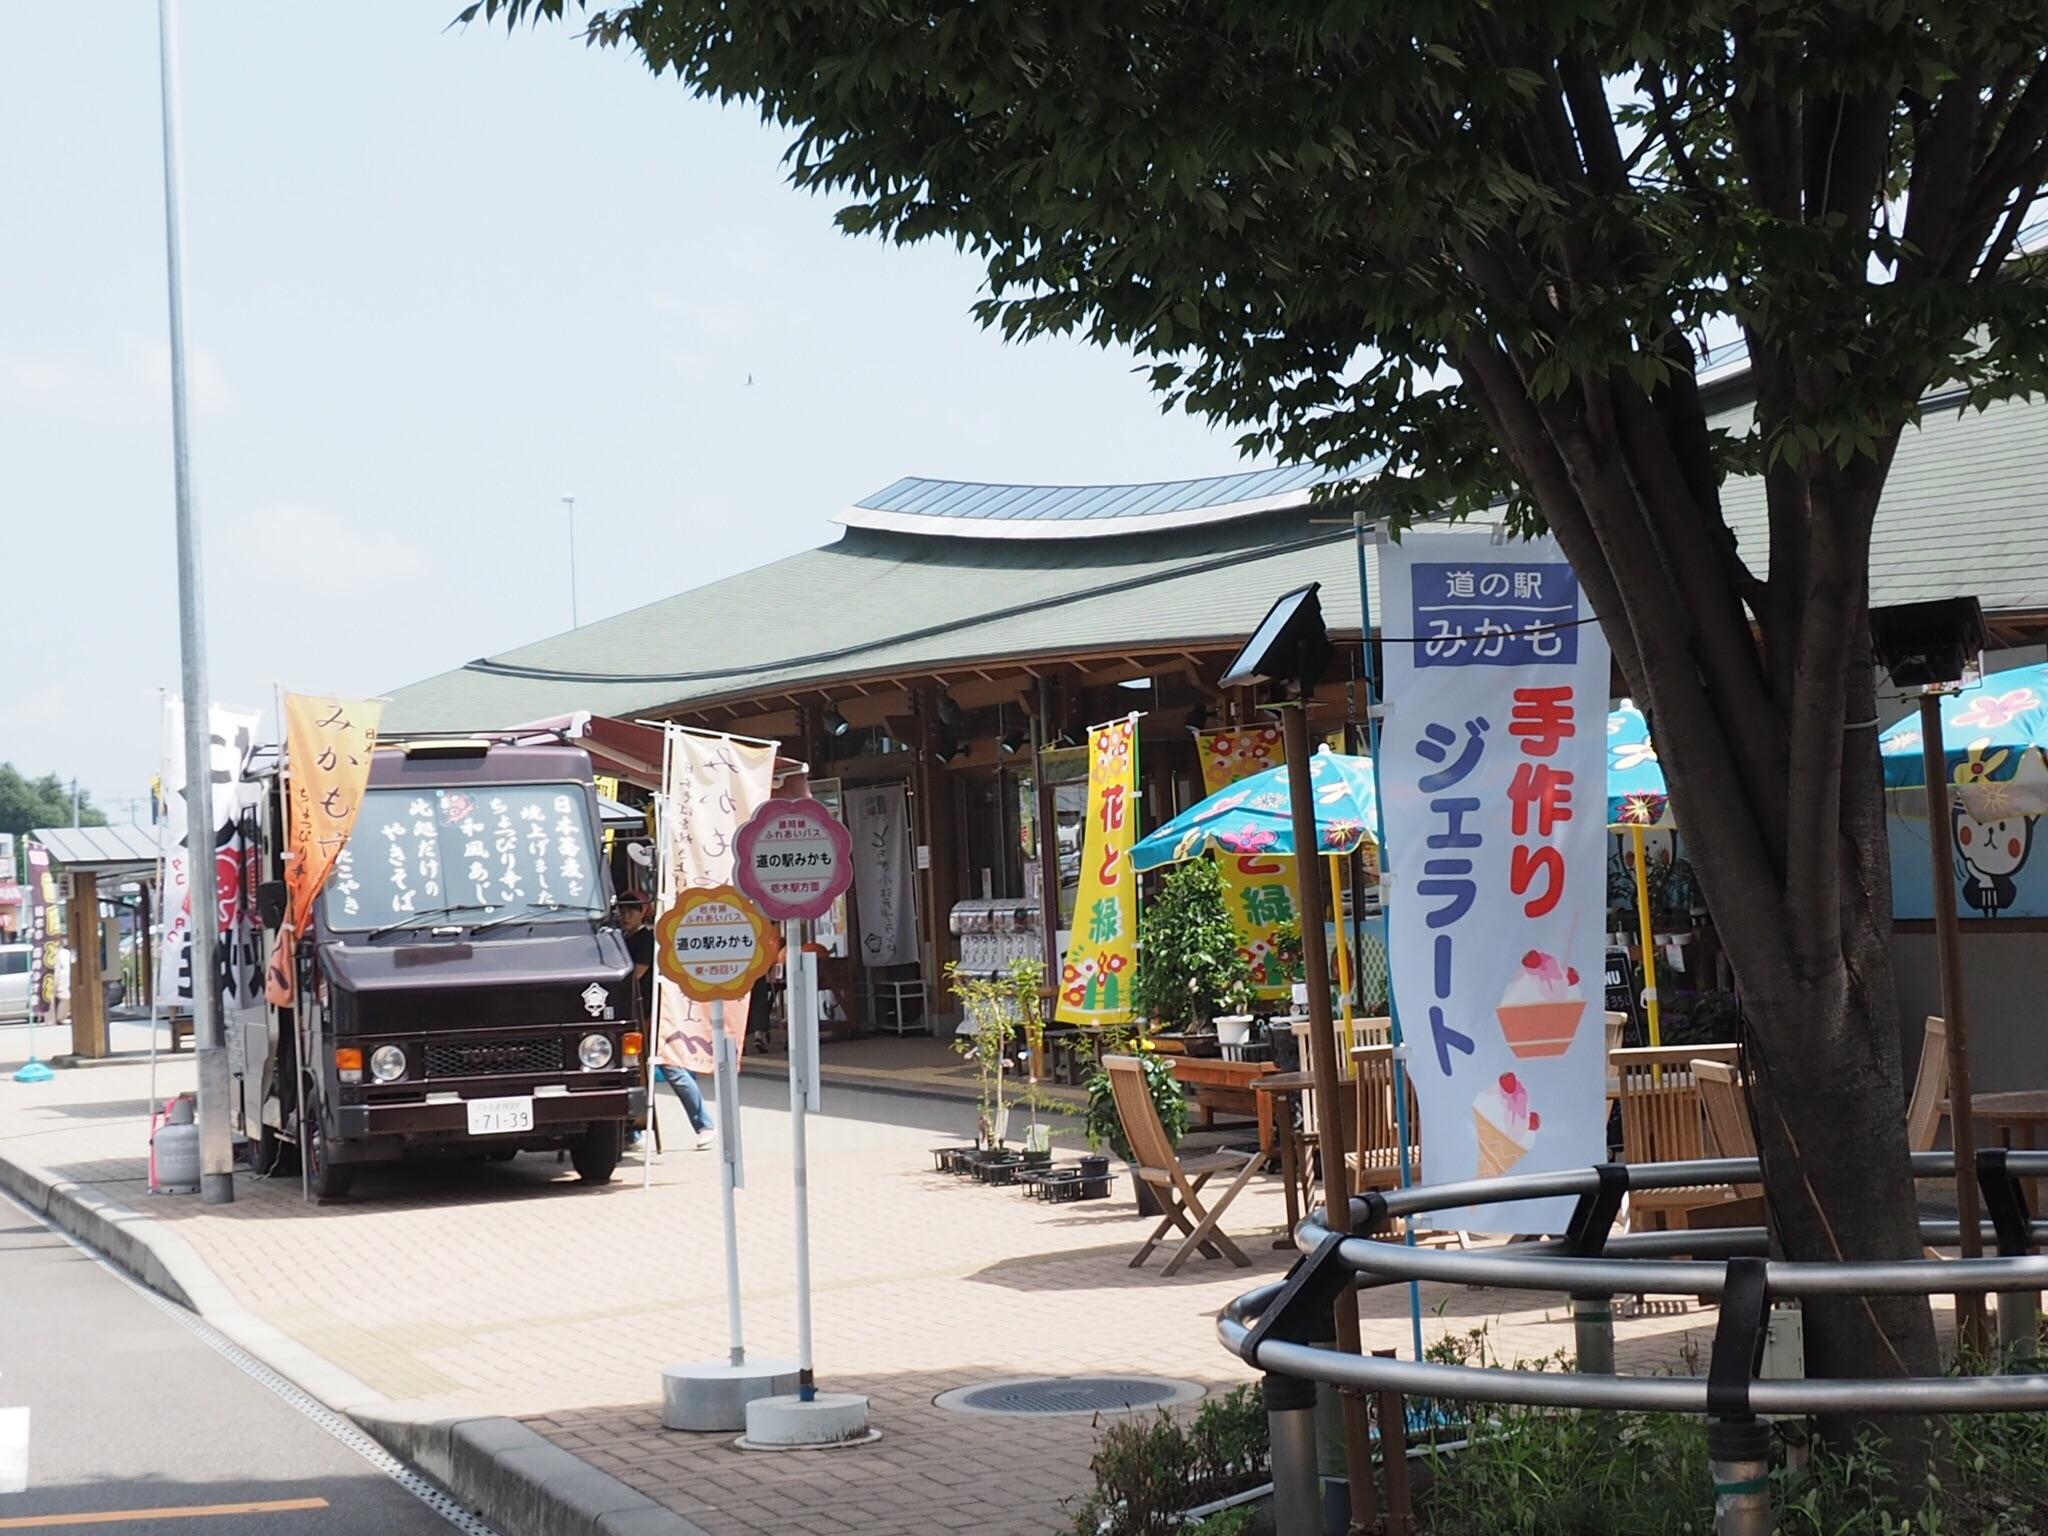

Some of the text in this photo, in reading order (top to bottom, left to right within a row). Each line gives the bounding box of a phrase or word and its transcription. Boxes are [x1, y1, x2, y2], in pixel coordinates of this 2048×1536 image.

[1445, 570, 1543, 601] 道の駅
[1424, 616, 1564, 659] みかも
[1506, 685, 1576, 919] 手作り
[765, 828, 822, 839] ふれあいバス
[380, 822, 417, 913] やきそば
[756, 851, 832, 869] 道の駅みかも
[1089, 784, 1127, 945] 花と緑
[335, 849, 361, 916] たこやき
[1414, 715, 1491, 1078] ジェラート
[685, 912, 744, 924] ふれあいバス
[676, 933, 753, 951] 道の駅みかも
[1604, 970, 1621, 986] NU
